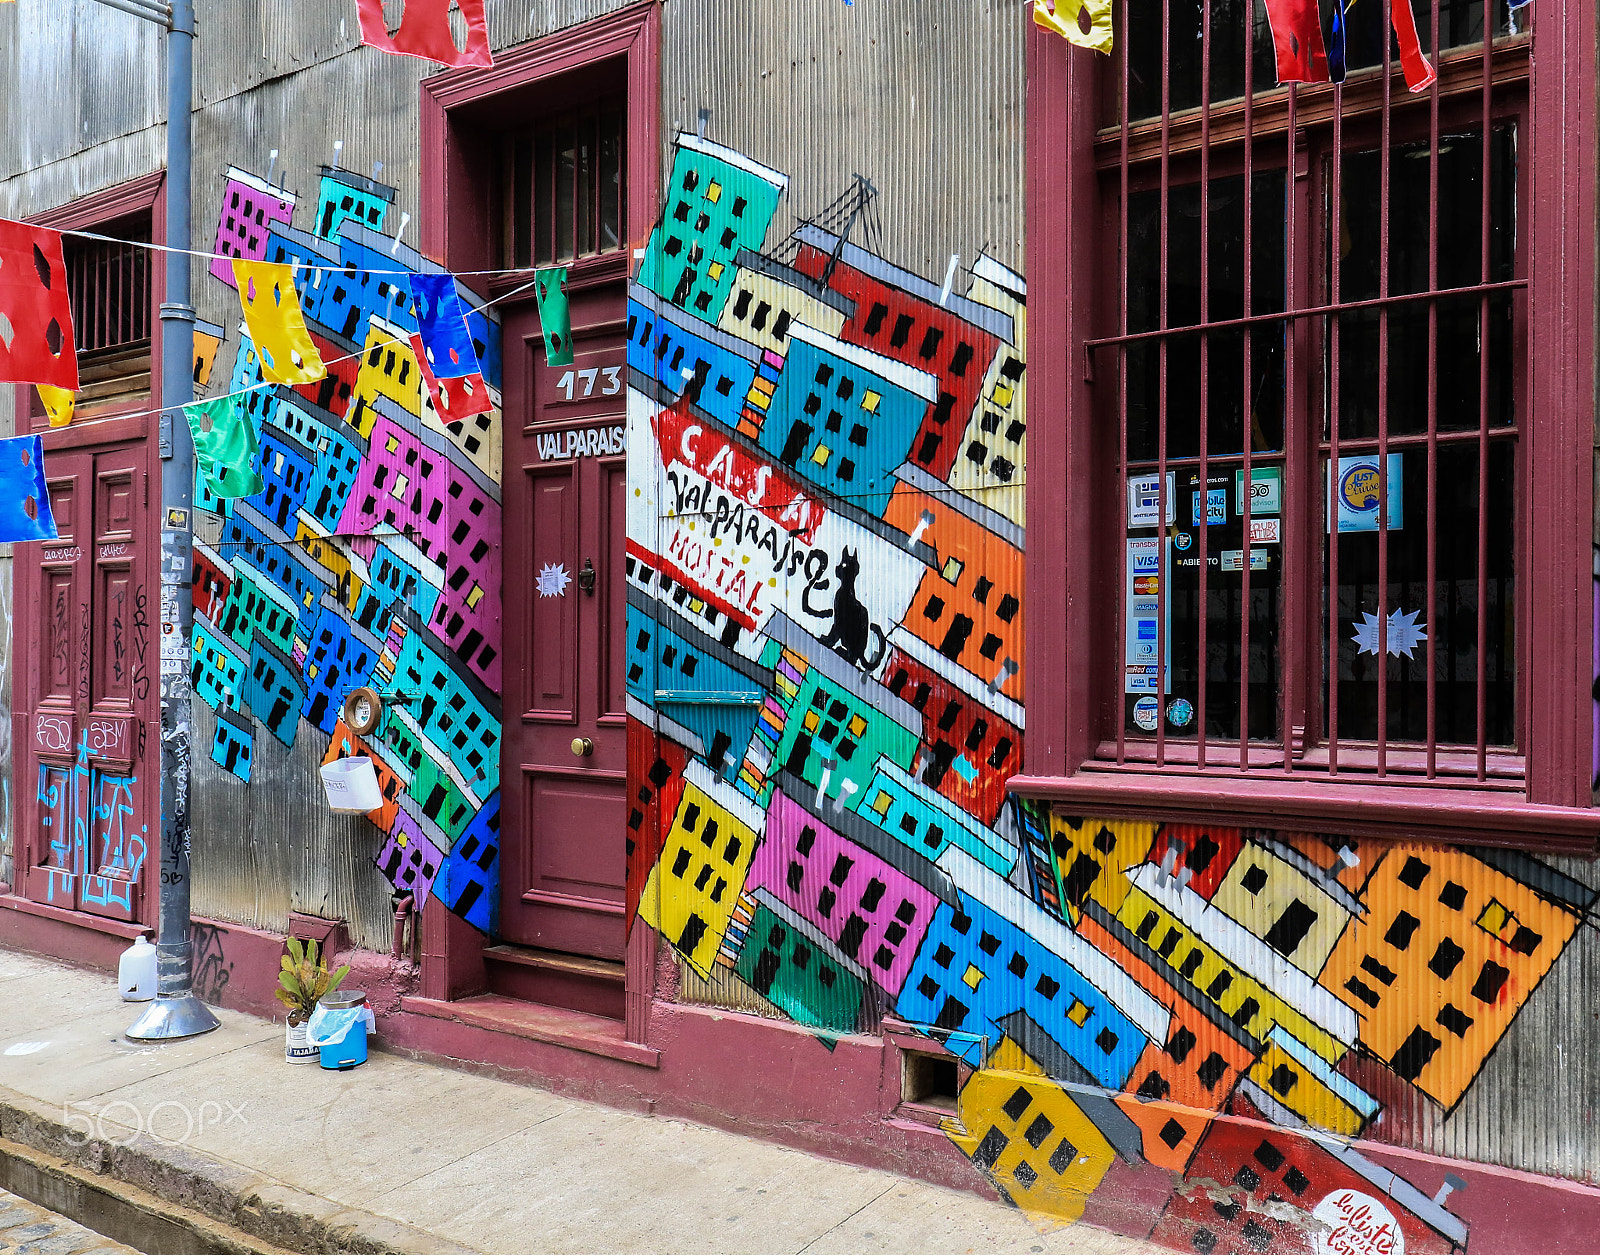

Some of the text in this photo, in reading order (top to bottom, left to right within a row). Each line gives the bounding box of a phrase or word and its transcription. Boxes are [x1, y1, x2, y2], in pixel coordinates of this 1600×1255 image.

[556, 366, 622, 400] 173
[1194, 496, 1224, 507] mbile
[1241, 500, 1274, 508] tadvisor
[1135, 556, 1159, 566] VISA
[1182, 558, 1218, 566] ABIETO
[669, 530, 763, 615] HOSTAL
[293, 1047, 320, 1056] TAJAMA
